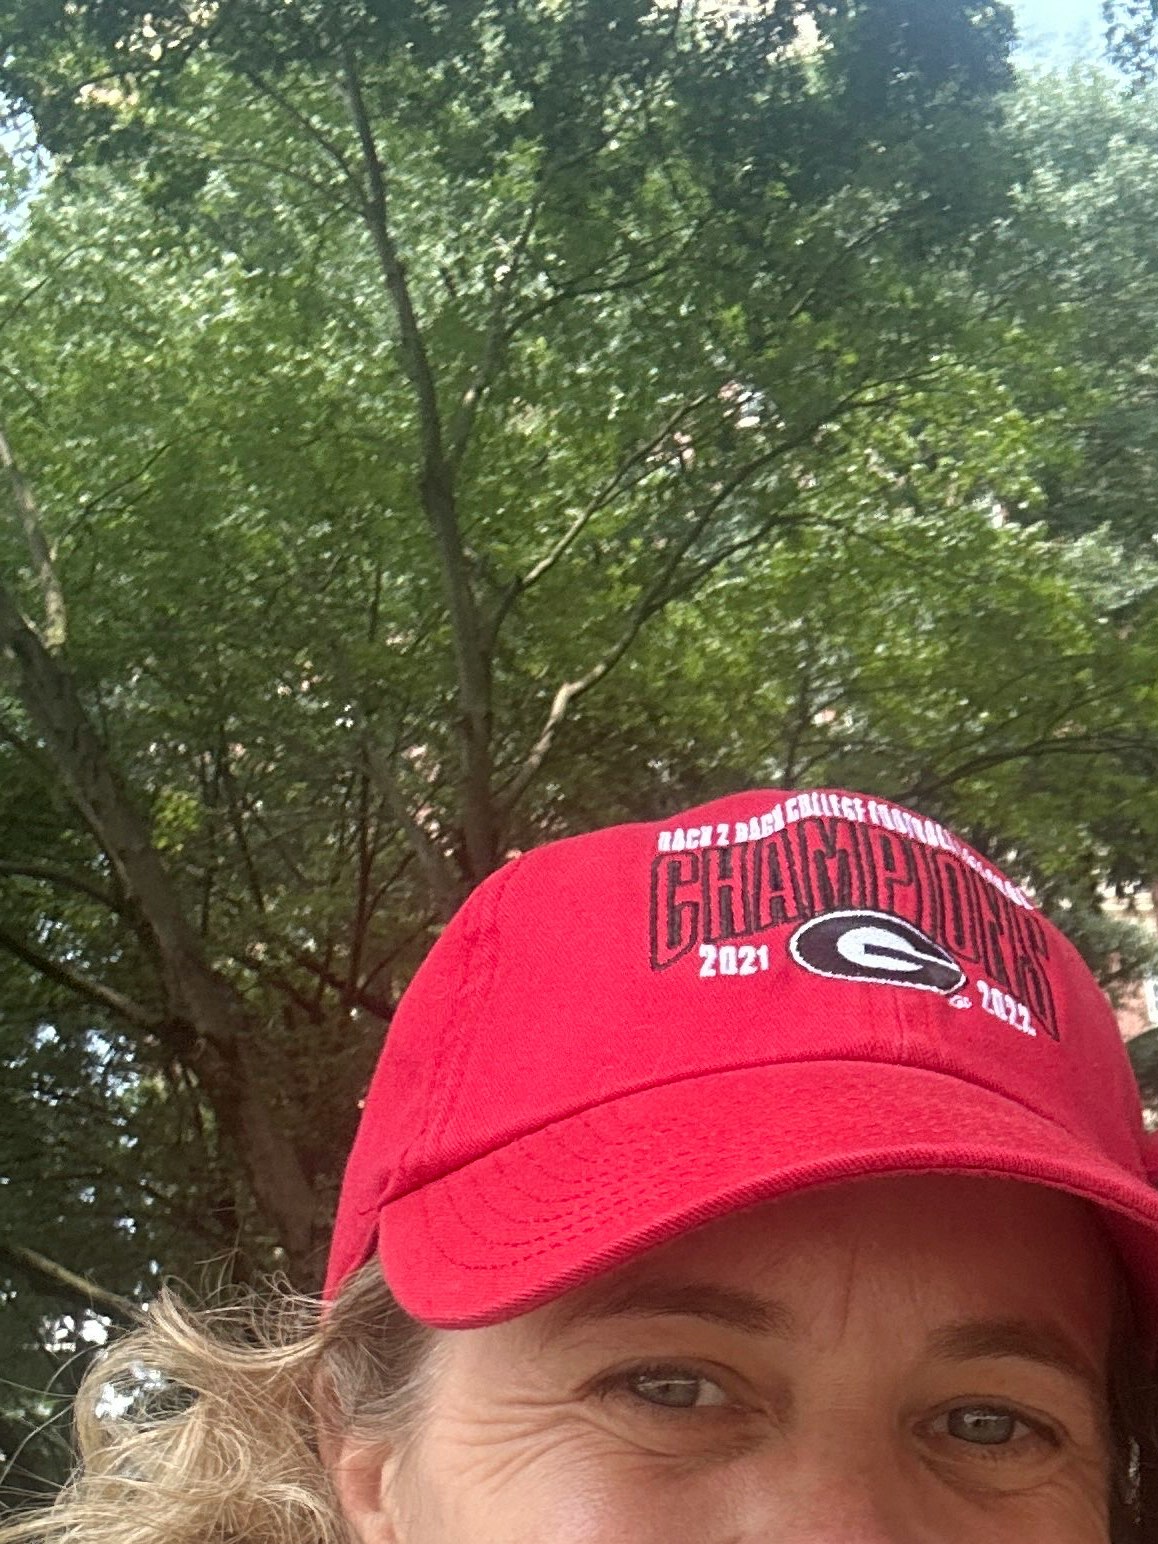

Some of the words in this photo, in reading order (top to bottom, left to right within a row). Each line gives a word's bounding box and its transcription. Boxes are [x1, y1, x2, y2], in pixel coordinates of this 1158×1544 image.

[716, 823, 730, 846] 2
[734, 803, 785, 844] BACK
[650, 817, 1060, 1042] CHAMPIONS
[698, 943, 769, 979] 2021
[976, 979, 1037, 1037] 2022
